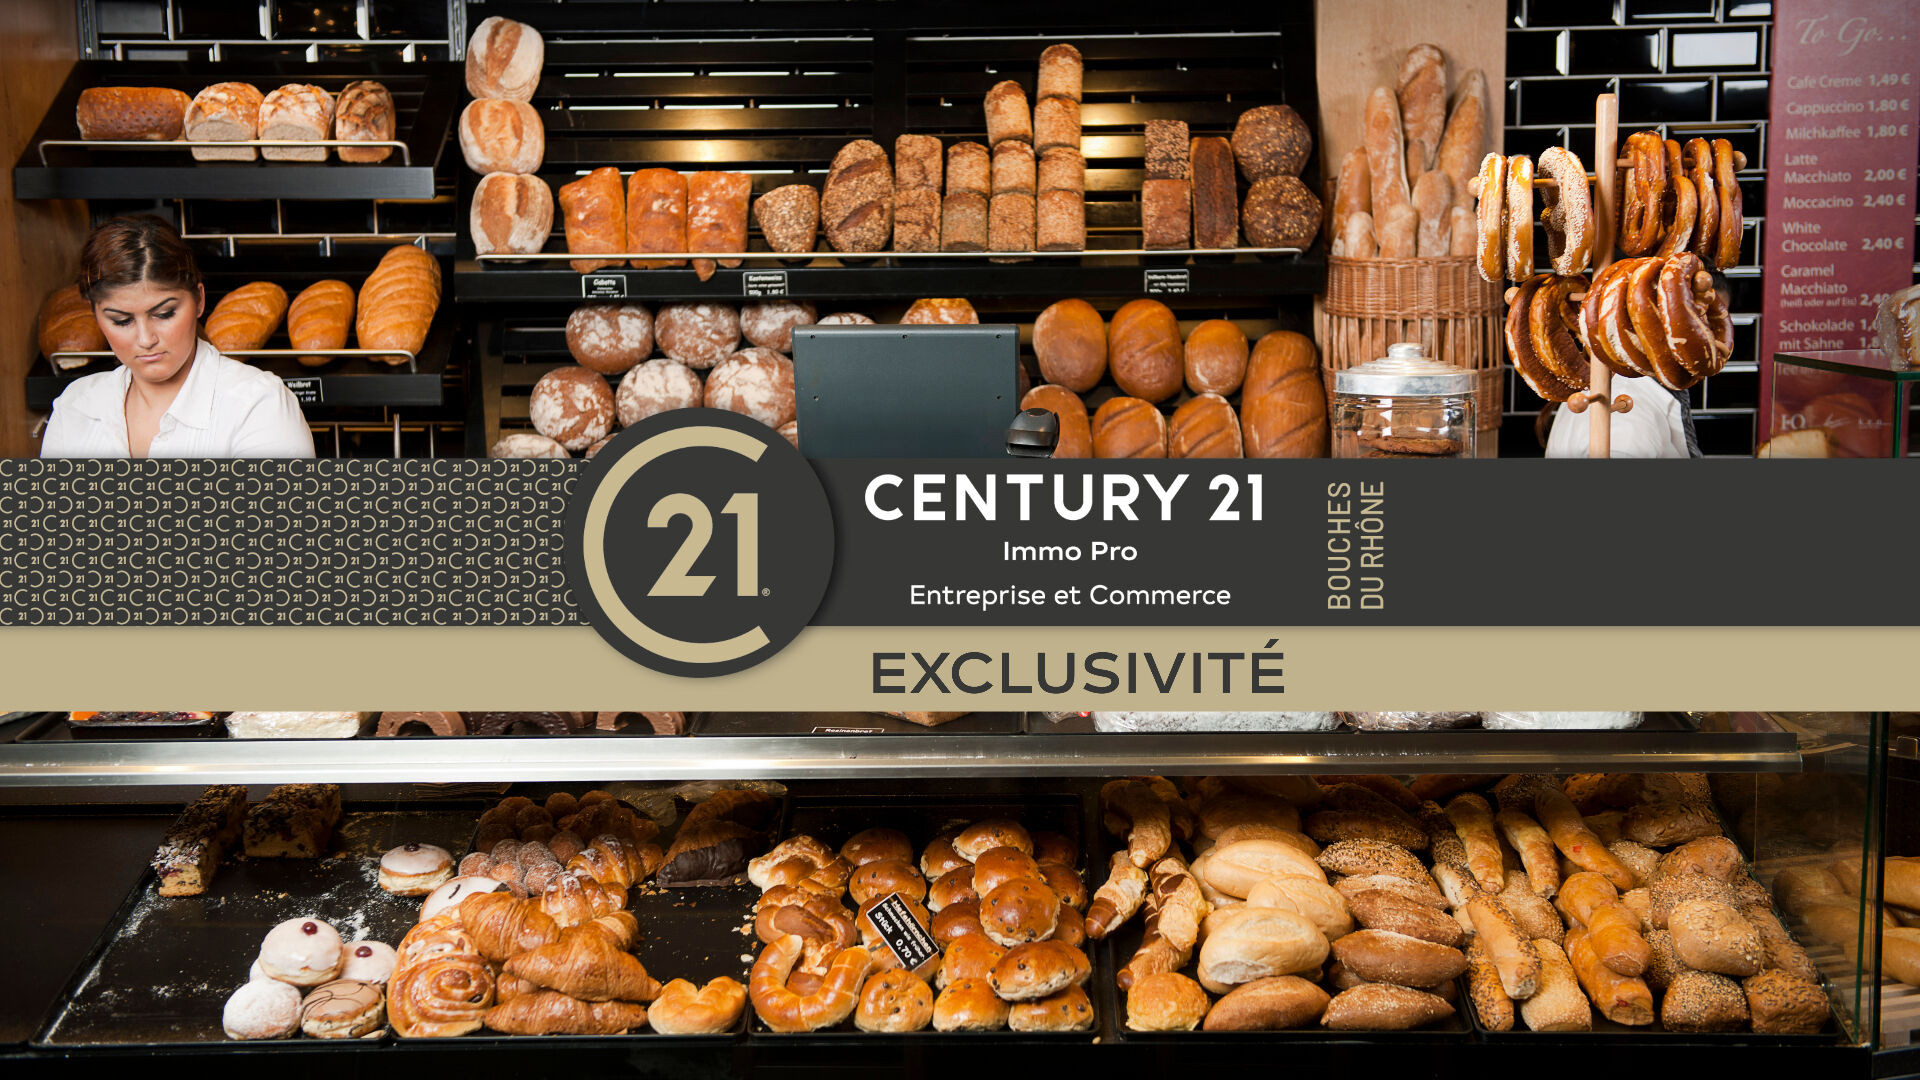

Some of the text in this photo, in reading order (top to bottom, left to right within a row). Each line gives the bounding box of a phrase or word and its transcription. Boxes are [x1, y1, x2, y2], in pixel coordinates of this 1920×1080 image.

[1796, 14, 1829, 45] To
[1787, 73, 1911, 89] Cafe Creme 1,49 €
[1786, 99, 1909, 116] Cappuccino 1,80 €
[1785, 124, 1908, 140] Milchkaffee 1,80 €
[1784, 153, 1818, 166] Latte
[1784, 168, 1907, 184] Macchiato 2,00 €
[1783, 194, 1906, 209] Moccacino 2,40 €
[1782, 222, 1821, 235] White
[1781, 237, 1904, 253] Chocolate 2,40 €
[1781, 264, 1835, 278] Caramel
[1780, 283, 1848, 296] Macchiato
[1779, 319, 1854, 333] Schokolade
[1779, 337, 1801, 351] mit
[1804, 337, 1844, 350] Sahne
[875, 912, 893, 934] Stück
